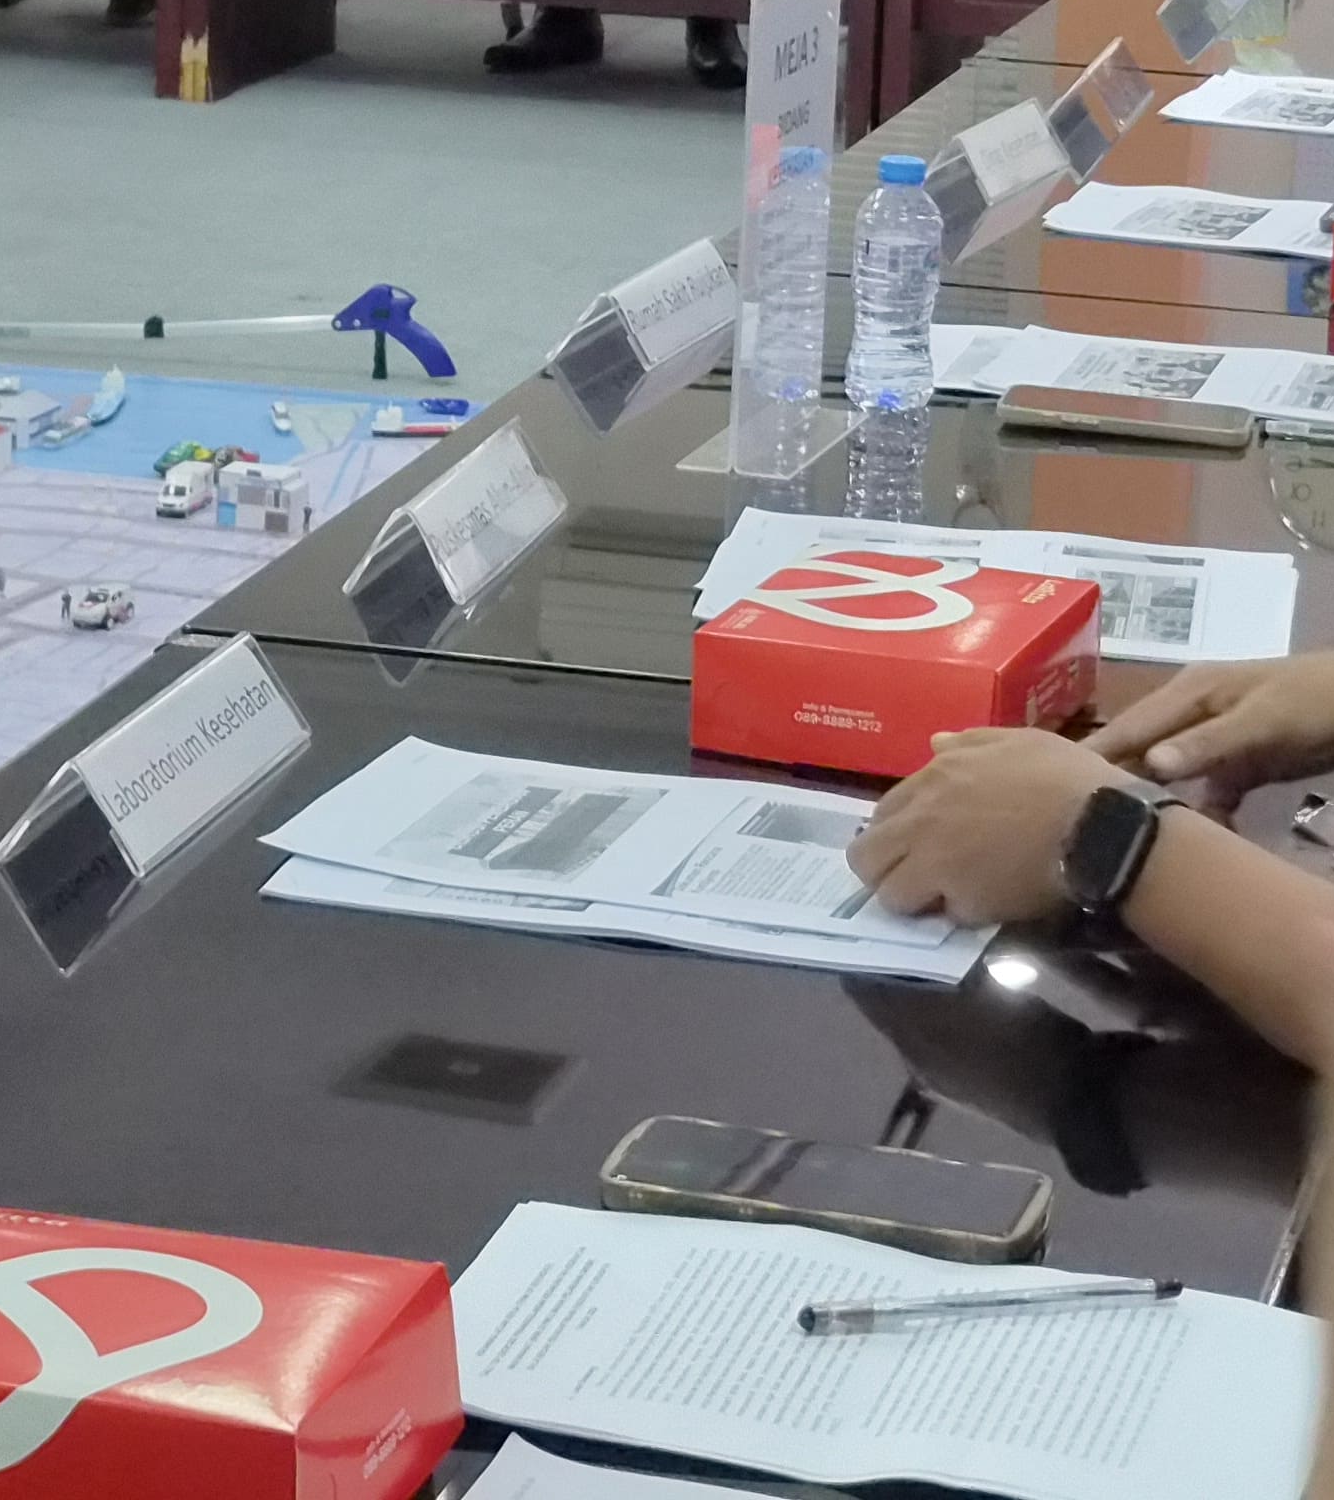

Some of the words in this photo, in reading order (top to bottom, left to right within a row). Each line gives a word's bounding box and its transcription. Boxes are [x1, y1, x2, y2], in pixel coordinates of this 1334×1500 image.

[774, 30, 808, 82] MEJA
[811, 26, 820, 63] 3
[102, 743, 208, 823] Laboratorium
[195, 679, 277, 748] Kesehatan
